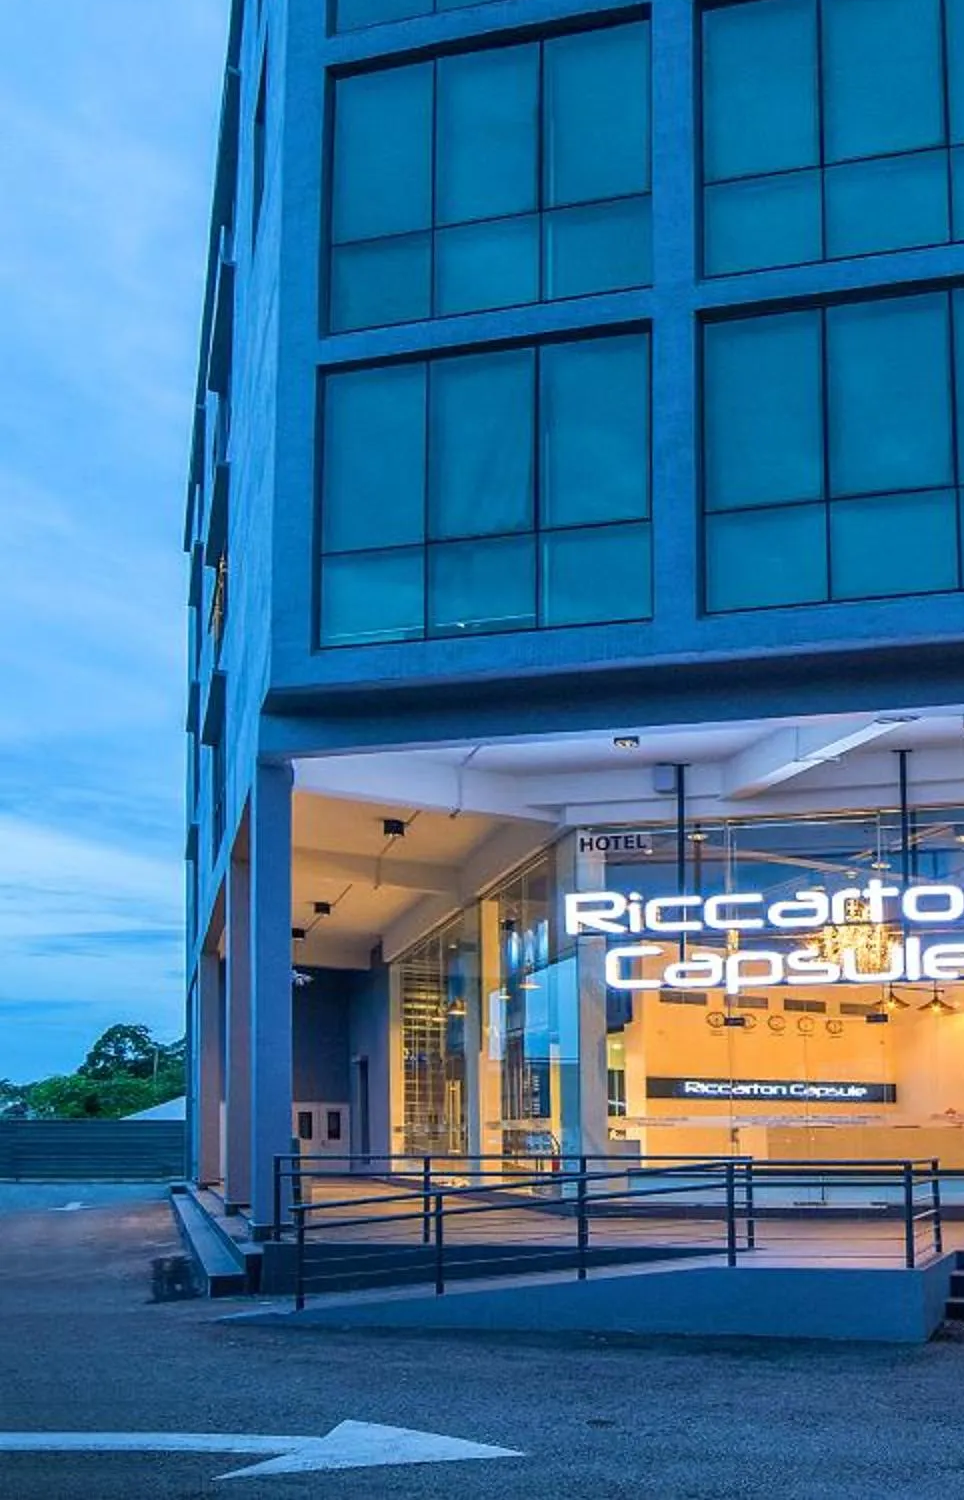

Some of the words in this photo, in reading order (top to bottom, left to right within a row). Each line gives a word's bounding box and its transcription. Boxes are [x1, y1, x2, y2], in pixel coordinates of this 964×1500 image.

[579, 834, 647, 853] HOTEL
[684, 1080, 787, 1096] Riccarton
[789, 1083, 868, 1099] Capsule
